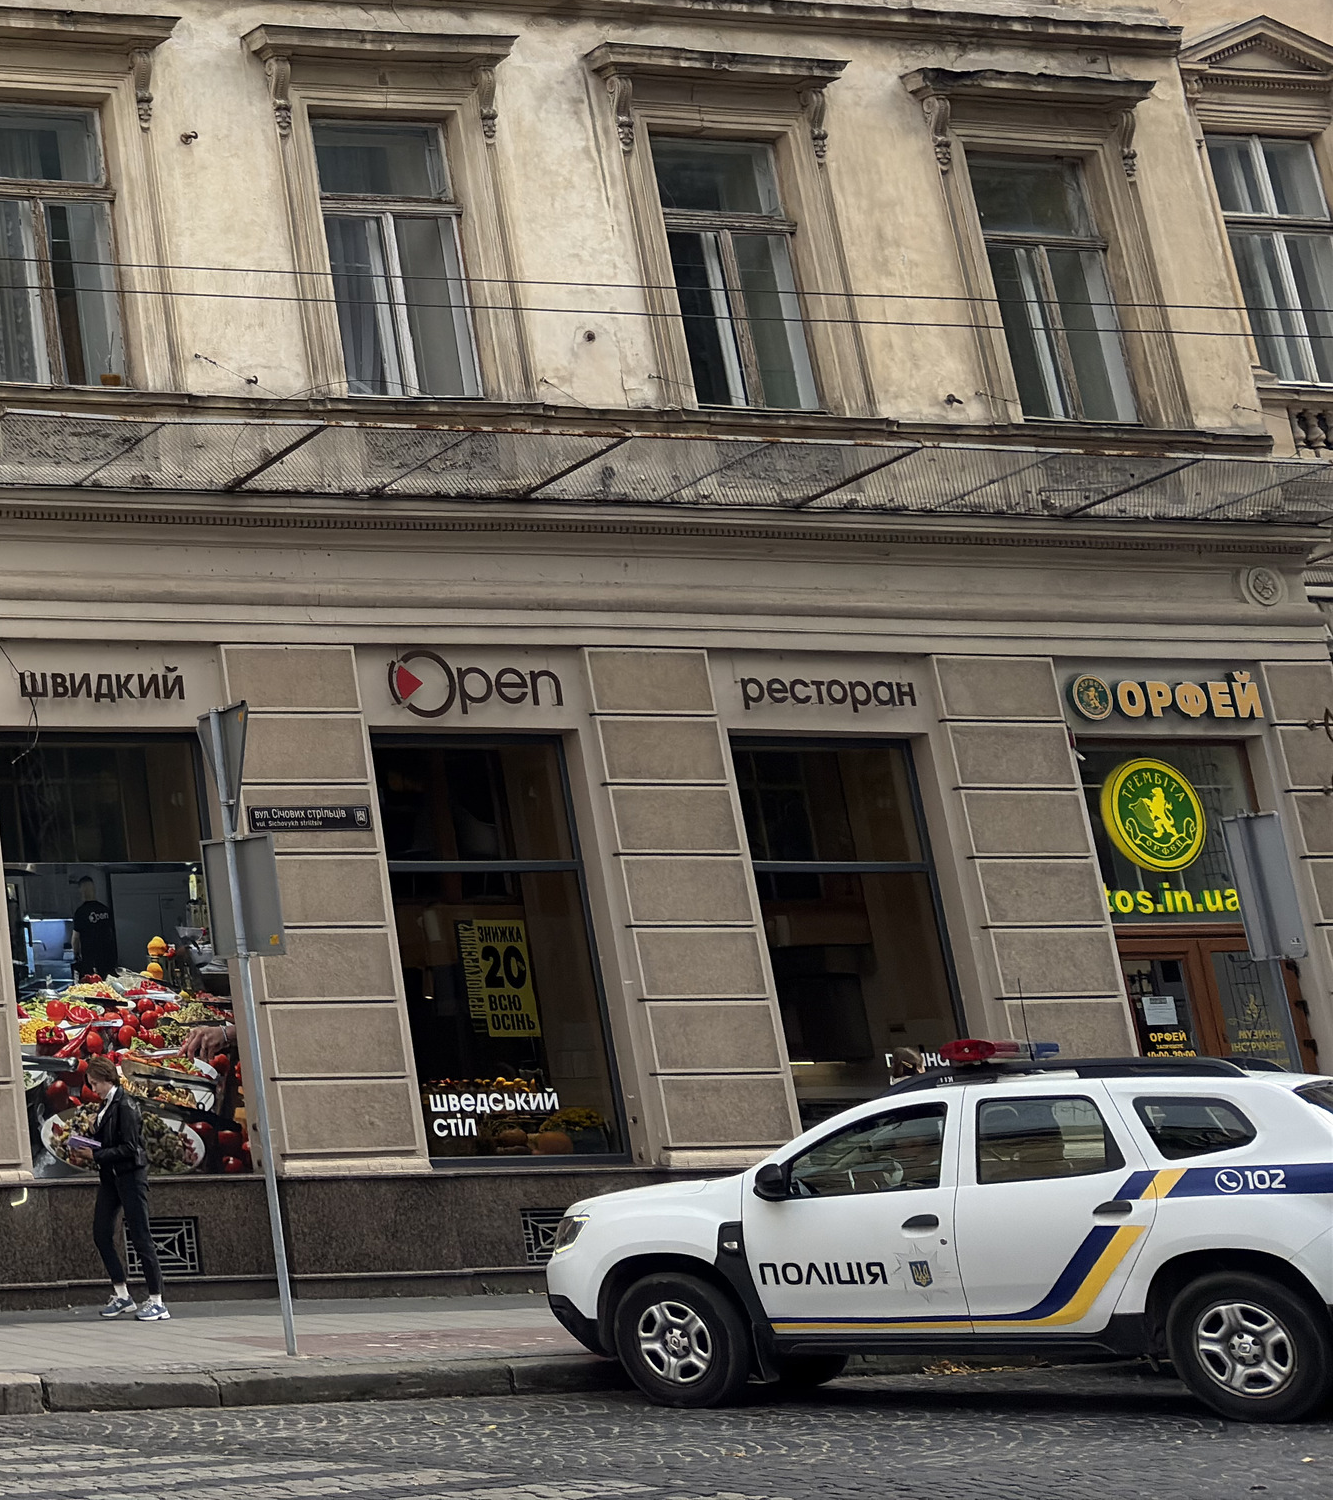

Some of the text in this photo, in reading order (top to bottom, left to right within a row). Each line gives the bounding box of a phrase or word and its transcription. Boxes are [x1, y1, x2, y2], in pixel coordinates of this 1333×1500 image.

[388, 650, 563, 718] Open
[740, 677, 917, 713] ресторан
[1117, 671, 1264, 718] ОРФЕЙ
[1121, 771, 1185, 802] ТРЕМБІТА
[254, 808, 347, 820] вул. Січових стрільців
[477, 925, 524, 943] ЗНИЖКА
[488, 994, 522, 1012] ВСЮ
[491, 1013, 536, 1031] ОСІНЬ
[1149, 1029, 1187, 1043] ОРФЕЙ
[429, 1088, 560, 1114] шведський
[433, 1113, 478, 1137] стіл
[1244, 1169, 1287, 1190] 102
[758, 1261, 888, 1287] ПОЛІЦІЯ
